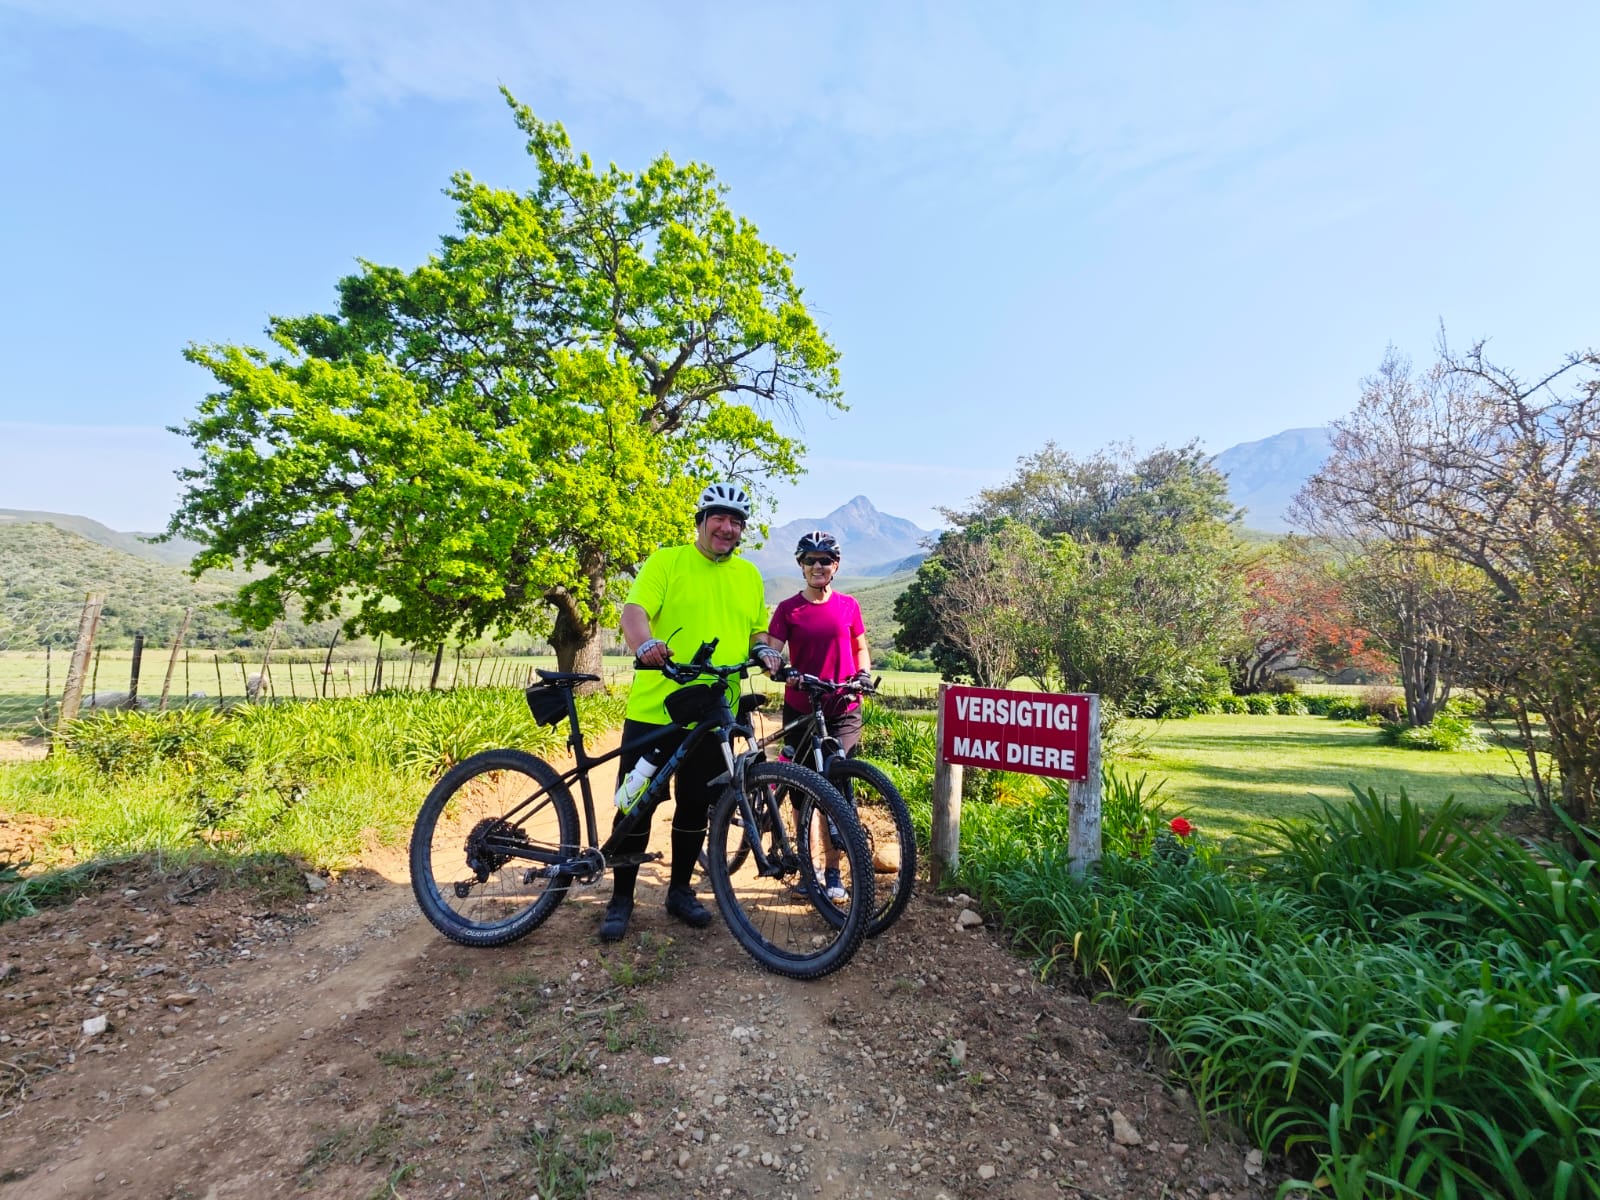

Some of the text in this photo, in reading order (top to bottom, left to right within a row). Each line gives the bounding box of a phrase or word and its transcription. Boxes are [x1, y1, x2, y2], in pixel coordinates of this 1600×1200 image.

[955, 695, 1078, 731] VERSIGTIG!
[953, 736, 1075, 772] MAK DIERE
